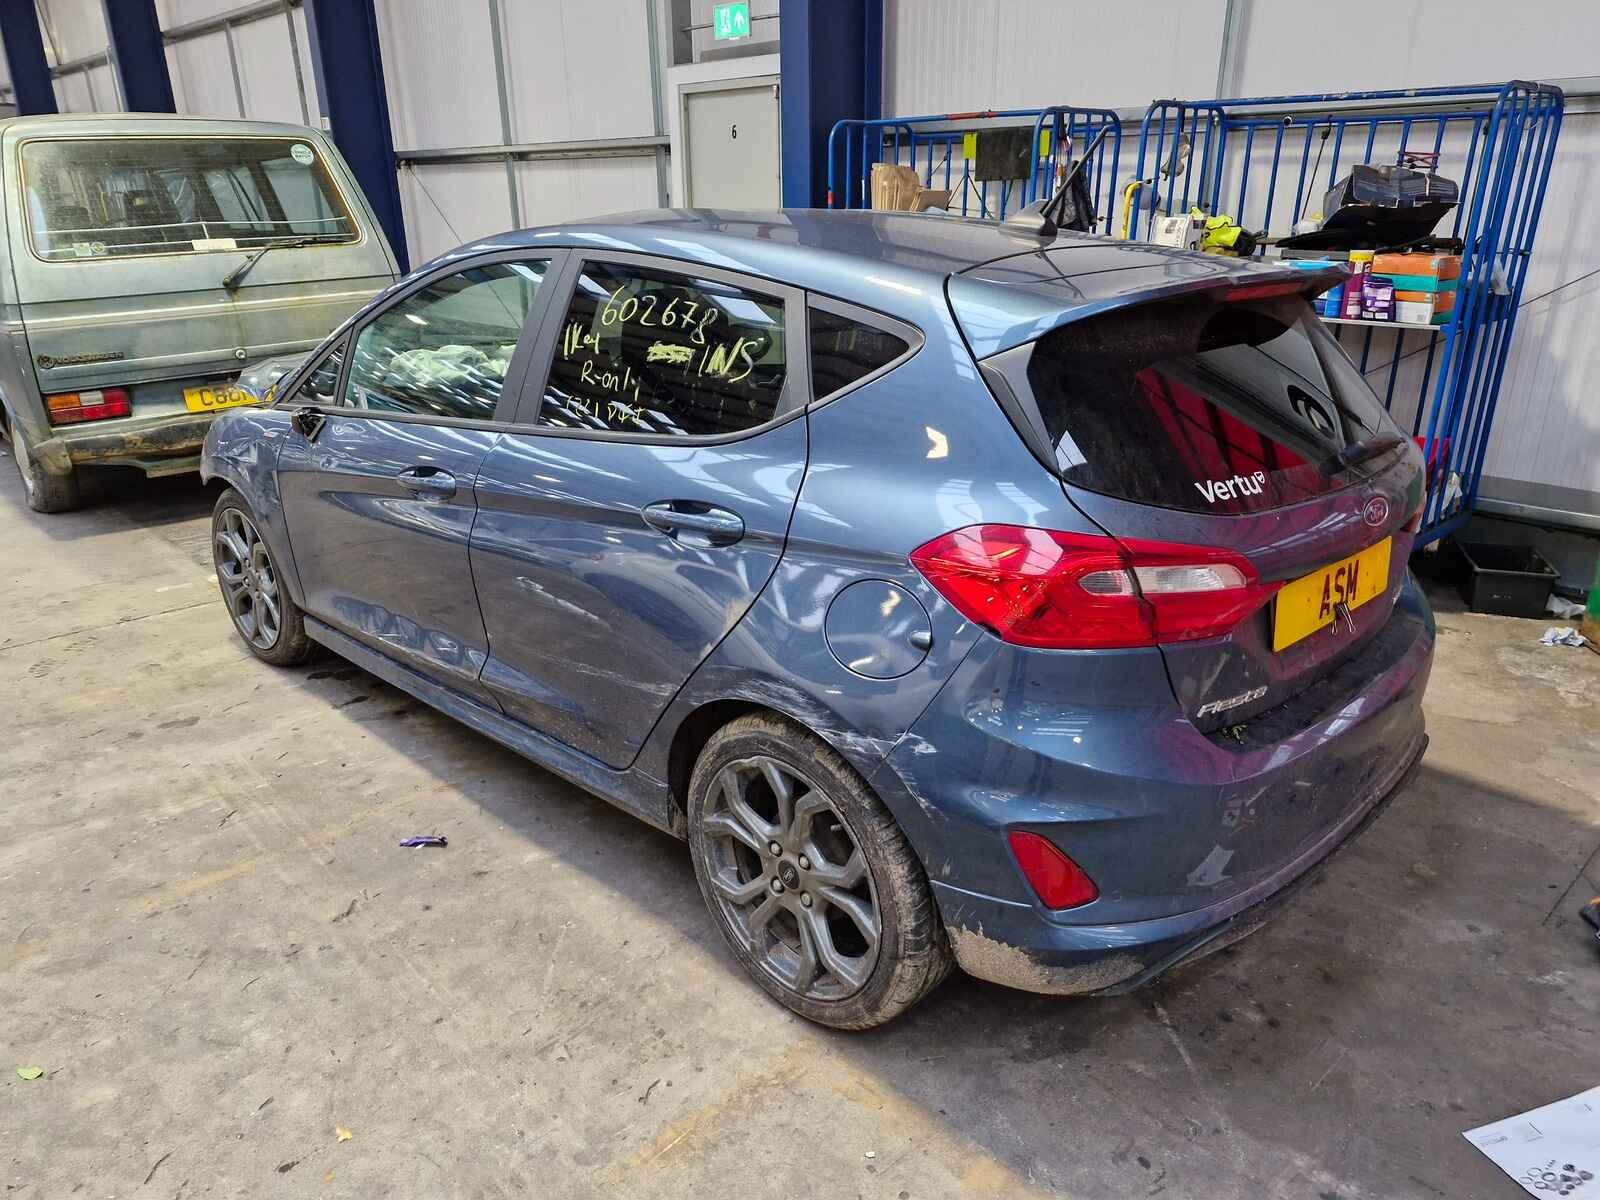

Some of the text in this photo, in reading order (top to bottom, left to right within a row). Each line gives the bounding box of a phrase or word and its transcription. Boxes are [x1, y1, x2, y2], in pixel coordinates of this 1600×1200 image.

[731, 124, 737, 139] 6
[601, 285, 718, 344] 602678
[1194, 474, 1264, 503] Vertu
[1319, 559, 1360, 619] ASM
